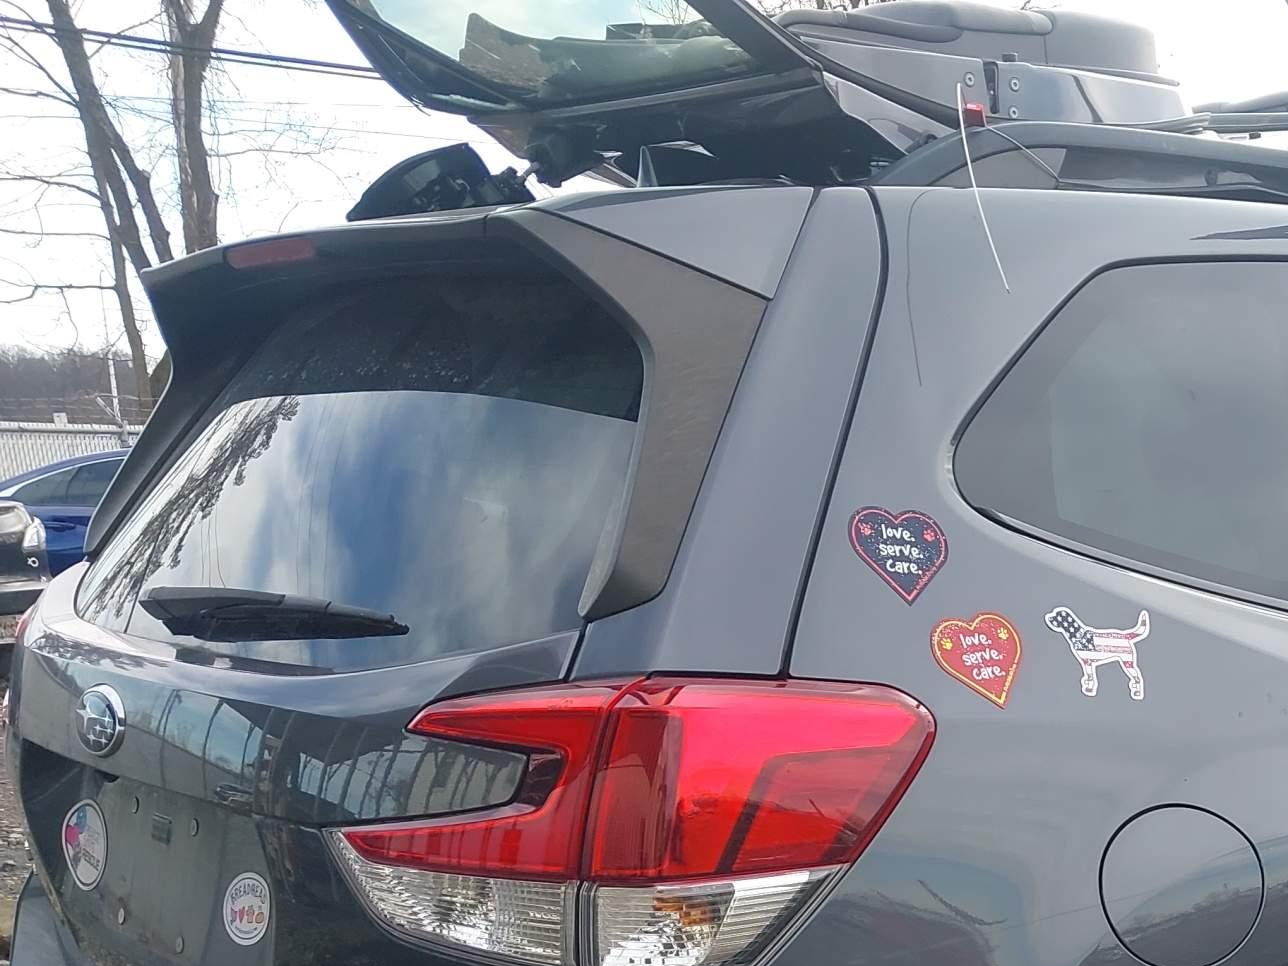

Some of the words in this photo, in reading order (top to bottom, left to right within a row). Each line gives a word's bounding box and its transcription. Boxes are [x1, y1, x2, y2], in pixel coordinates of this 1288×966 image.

[881, 524, 916, 541] love.
[879, 543, 924, 559] serve.
[959, 632, 992, 649] love.
[961, 647, 1004, 666] serve.
